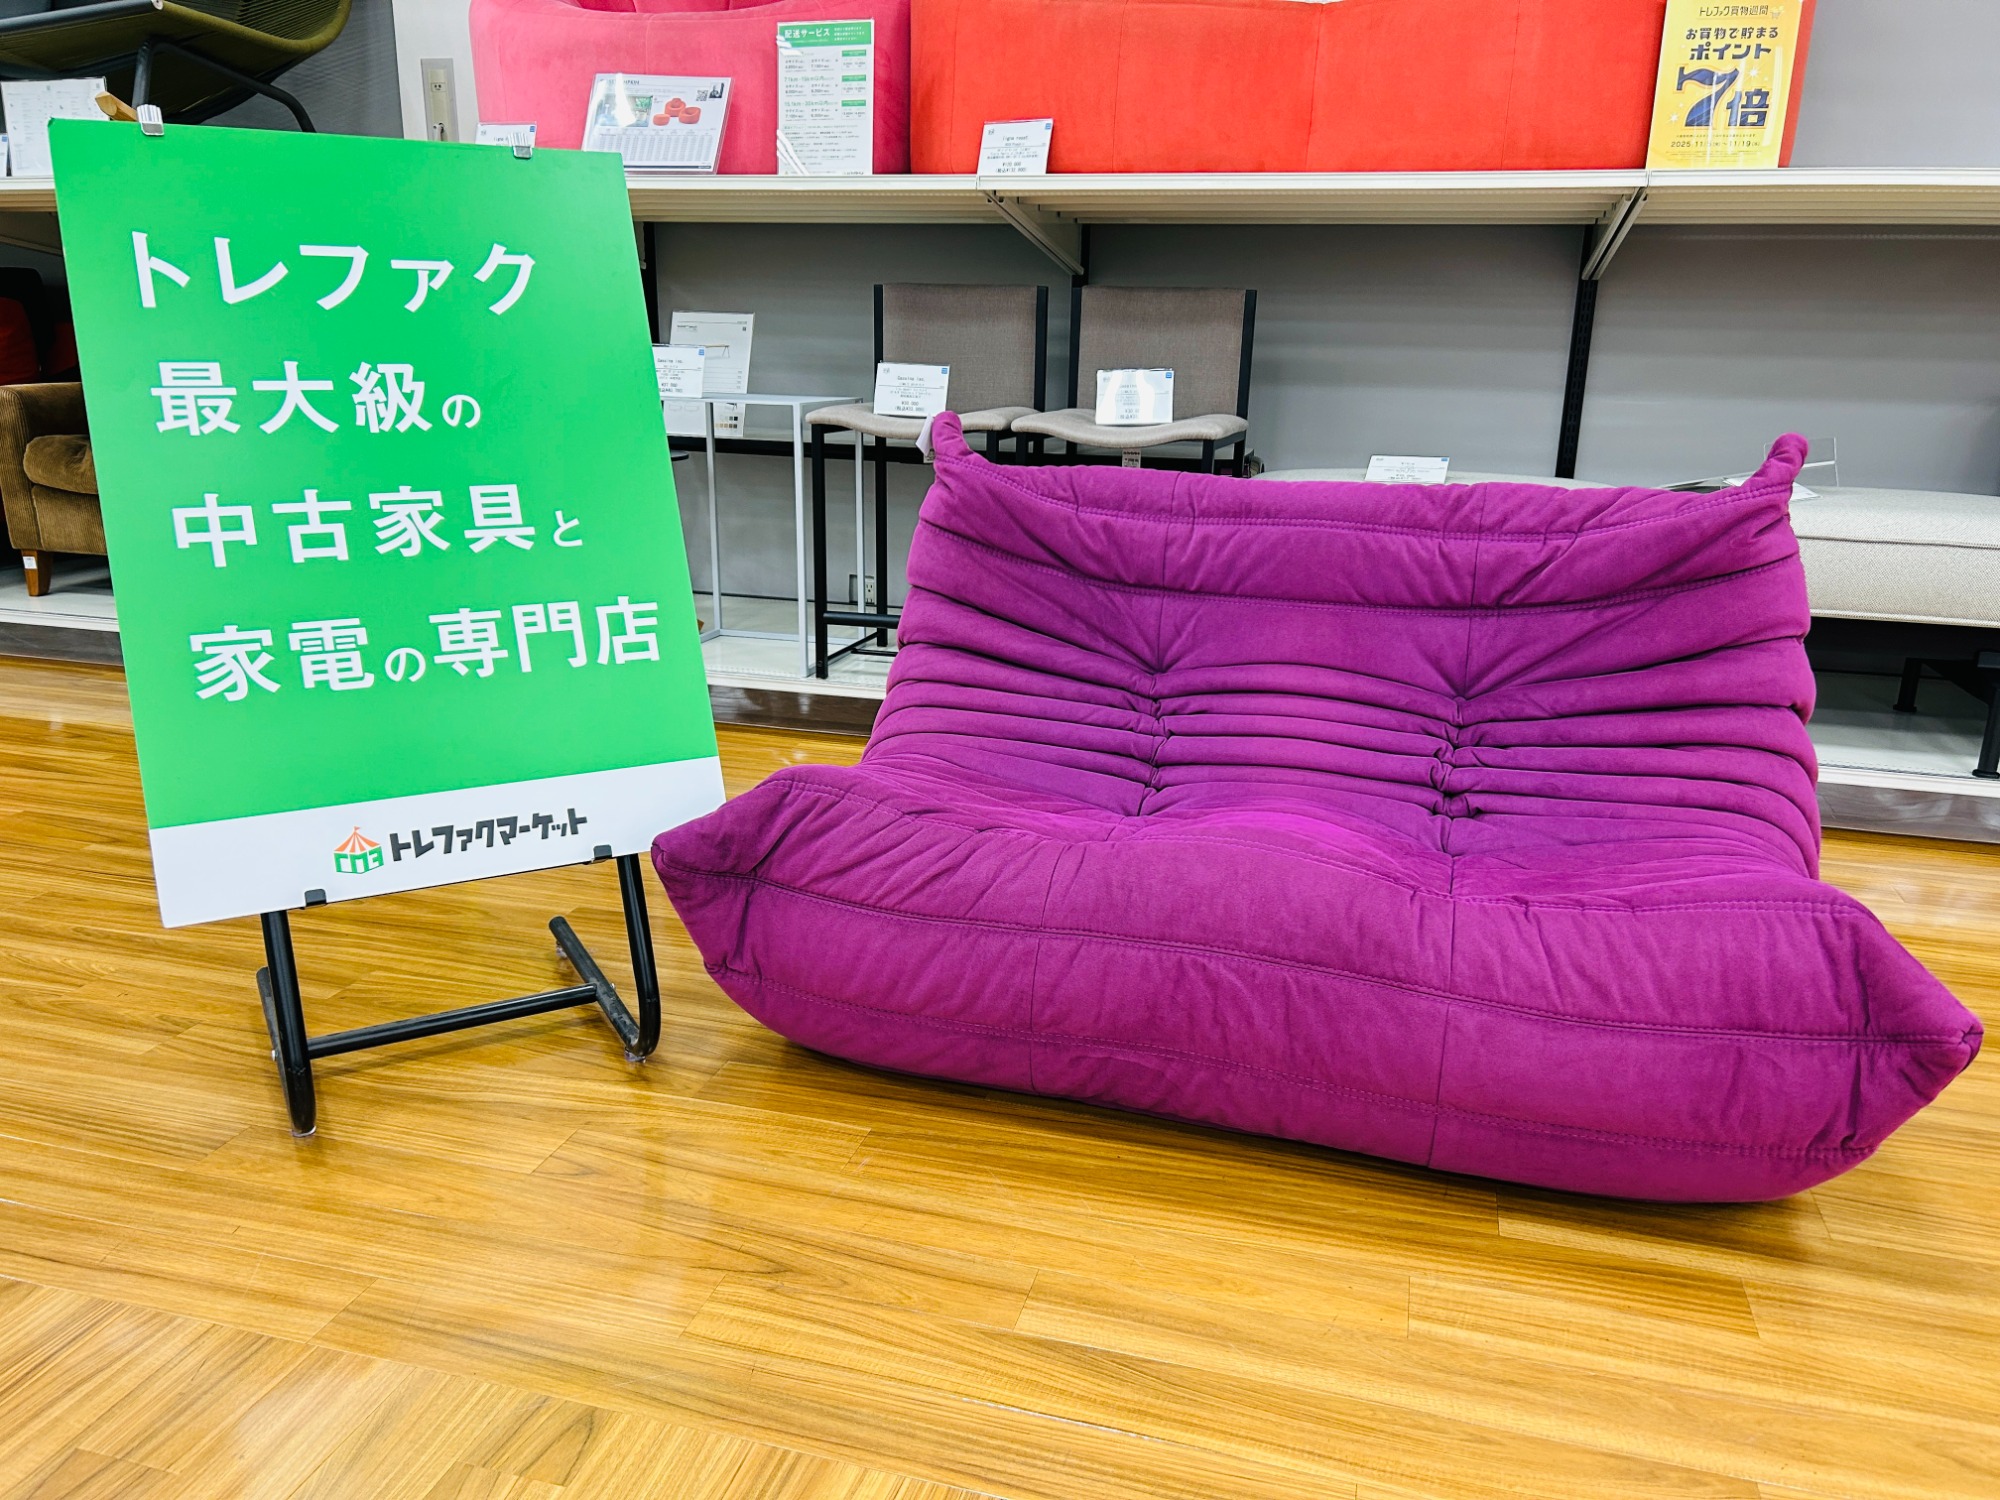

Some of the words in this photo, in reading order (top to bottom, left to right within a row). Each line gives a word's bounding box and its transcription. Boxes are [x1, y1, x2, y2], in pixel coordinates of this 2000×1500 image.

[784, 27, 831, 39] 配送サービス
[1686, 26, 1778, 40] お買物で貯まる
[1689, 41, 1772, 60] ポイント
[131, 230, 536, 316] トレファク
[150, 360, 482, 435] 最大級の
[172, 484, 584, 569] 中古家具と
[189, 596, 660, 702] 家電の専門店
[389, 808, 588, 862] トレファクマーケット
